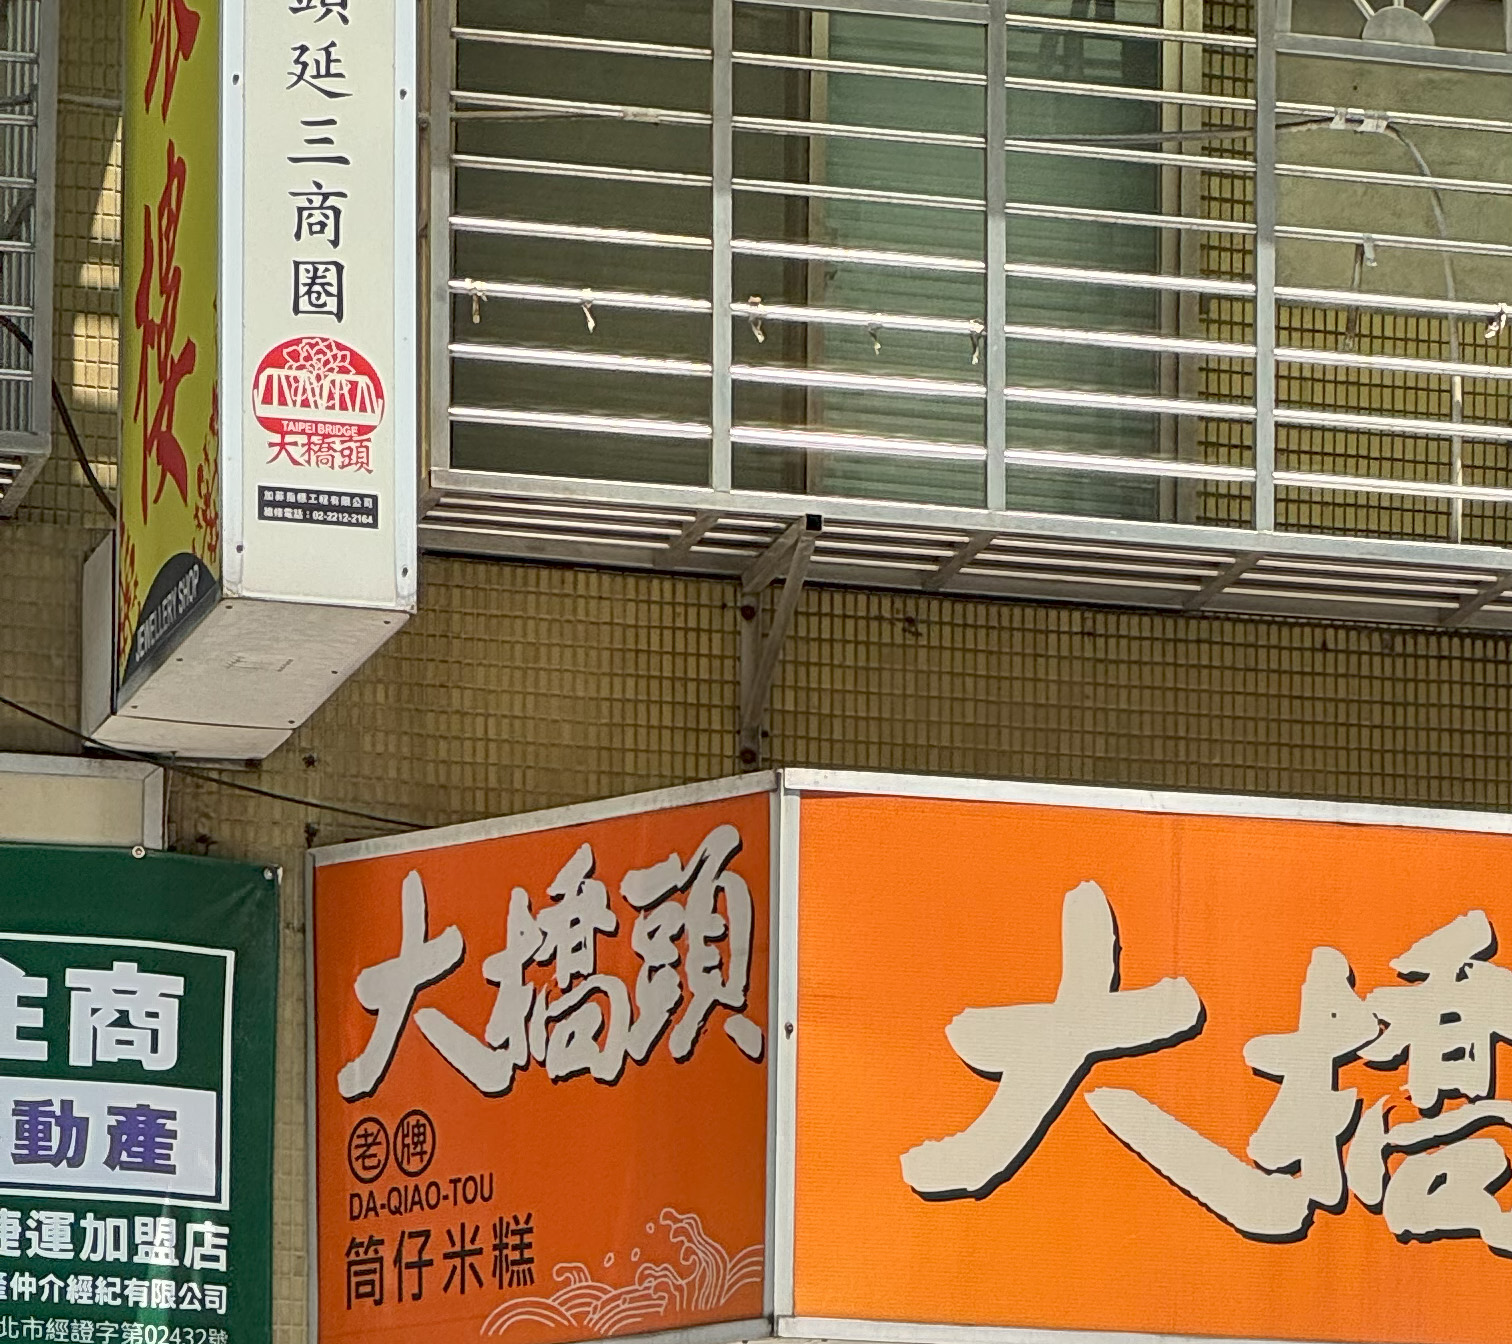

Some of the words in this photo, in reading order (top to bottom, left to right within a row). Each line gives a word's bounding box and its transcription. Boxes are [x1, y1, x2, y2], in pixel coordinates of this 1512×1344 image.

[265, 433, 375, 475] 大橋頭
[281, 420, 316, 434] TAIPEI
[317, 422, 359, 437] BRIDGE
[135, 586, 178, 662] JEWELLERY
[178, 564, 200, 614] SHOP
[337, 823, 765, 1103] 大橋頭
[347, 1108, 436, 1184] 老牌
[349, 1172, 495, 1222] DA-QIAO-TOU
[0, 1270, 227, 1315] 仲介經紀有限公司
[344, 1212, 536, 1310] 筒仔米糕
